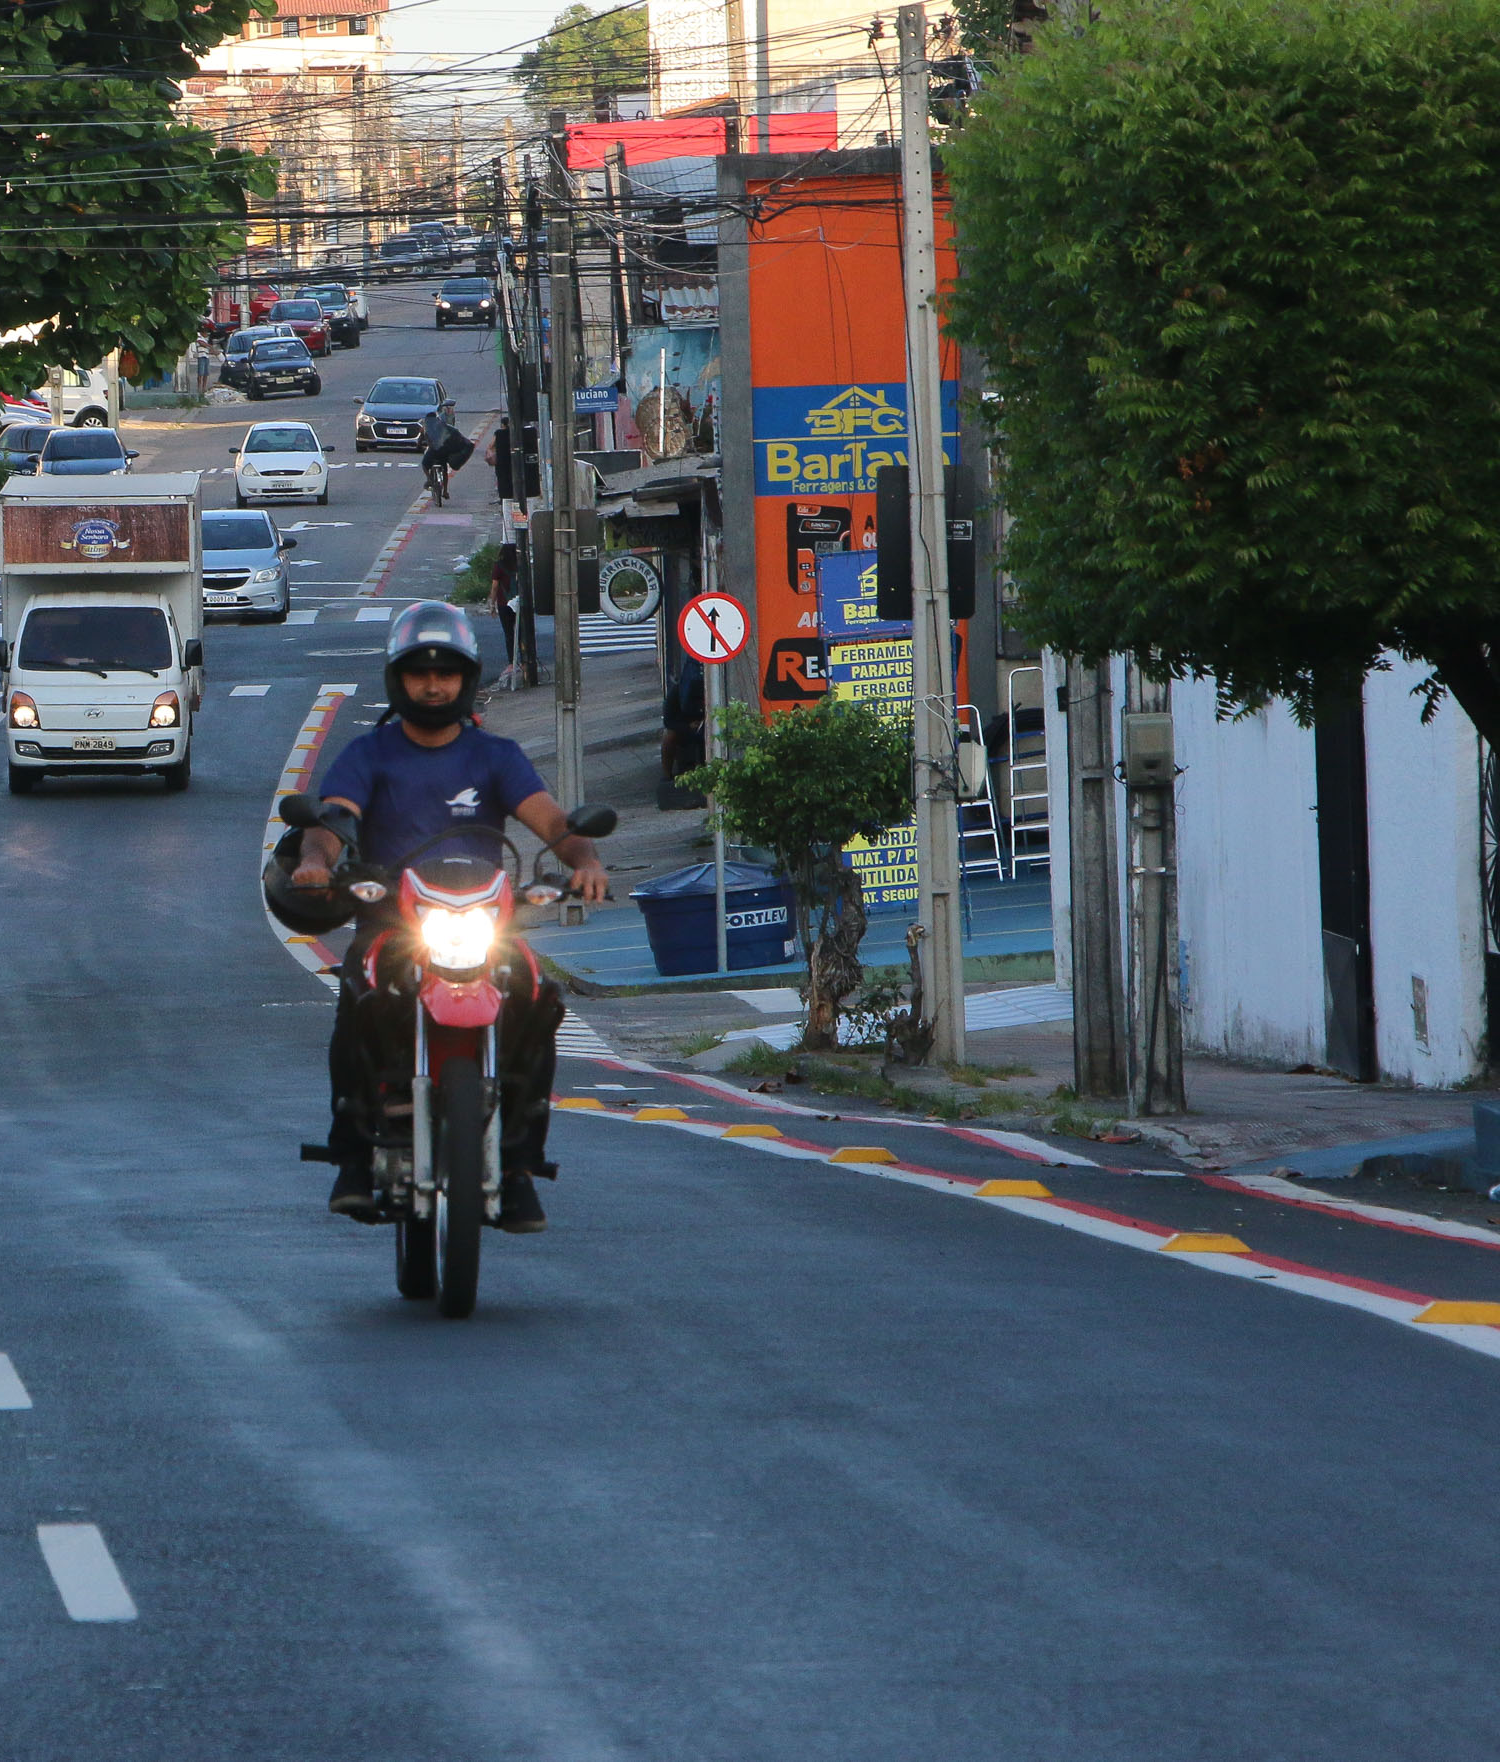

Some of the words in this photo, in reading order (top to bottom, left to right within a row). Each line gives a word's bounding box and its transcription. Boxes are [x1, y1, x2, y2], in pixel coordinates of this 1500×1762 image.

[576, 389, 608, 399] Luciano
[792, 478, 854, 494] Ferragens
[841, 645, 913, 662] FERRAMEN
[851, 661, 913, 679] PARAFUS
[853, 680, 913, 696] FERRAGE
[851, 851, 883, 867] MAT.
[725, 909, 786, 927] ORTLEV
